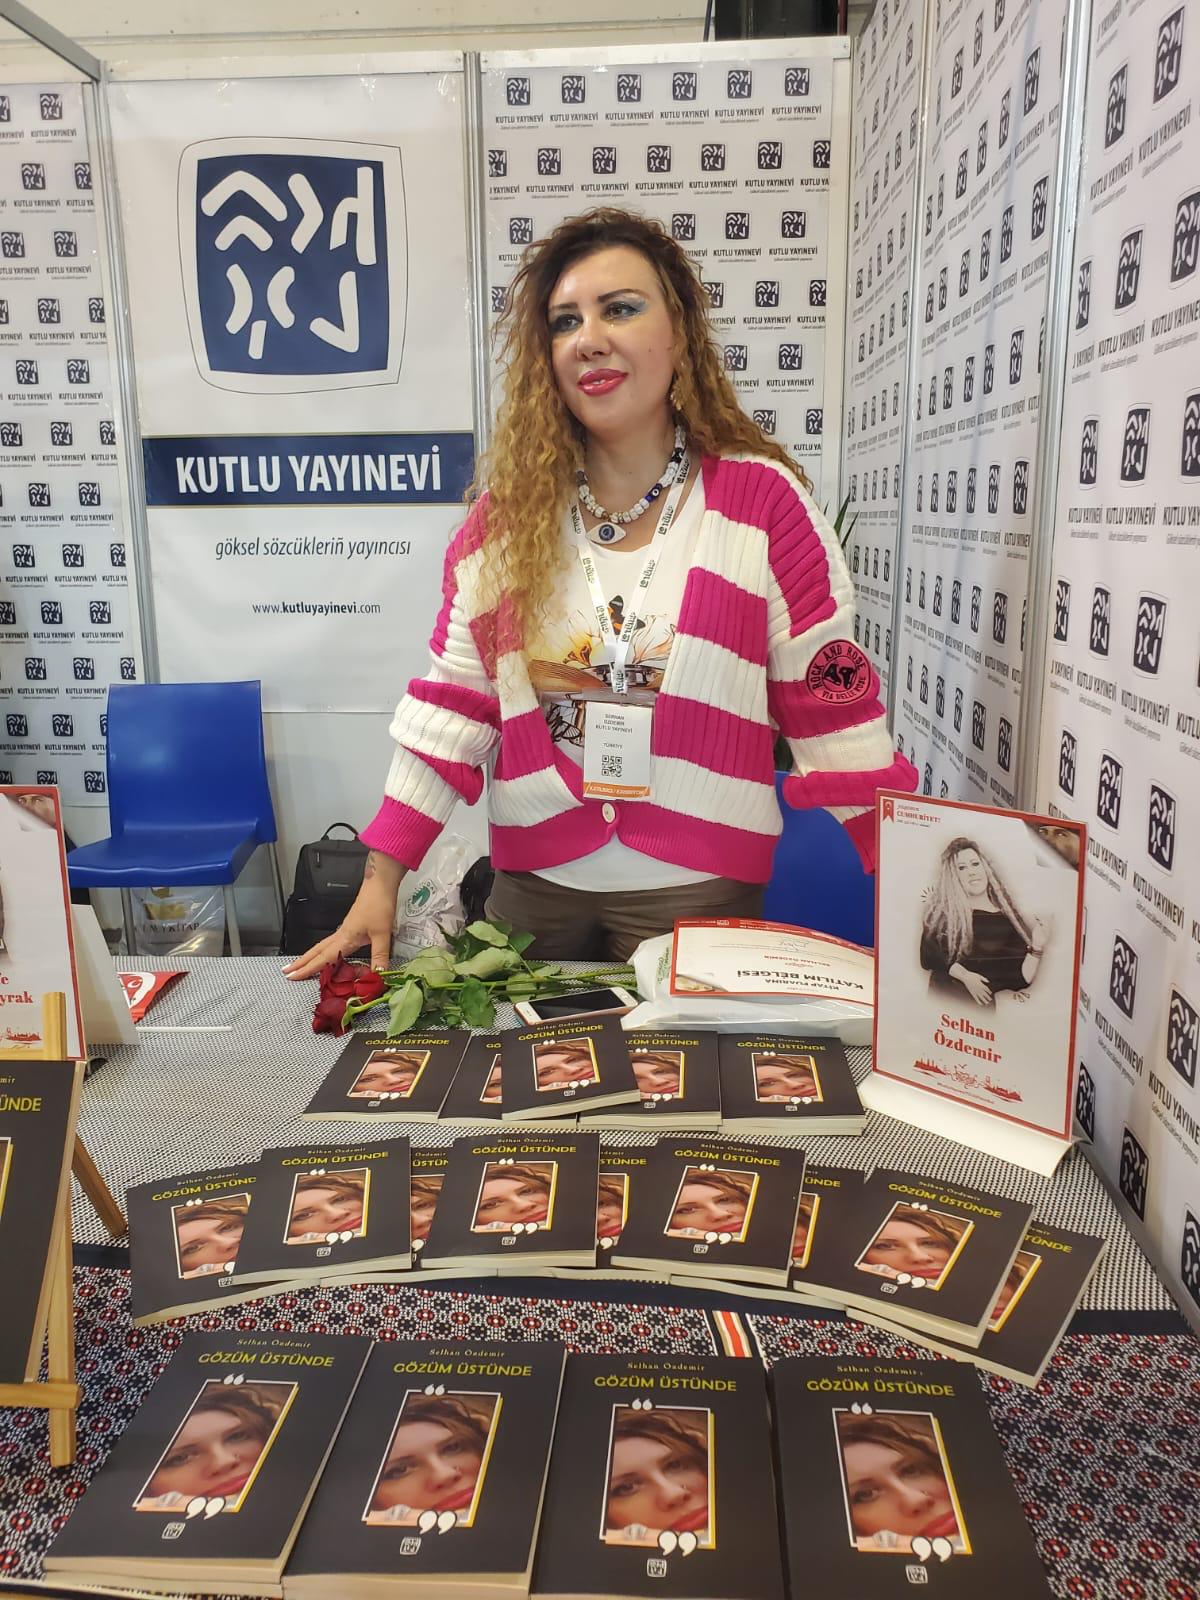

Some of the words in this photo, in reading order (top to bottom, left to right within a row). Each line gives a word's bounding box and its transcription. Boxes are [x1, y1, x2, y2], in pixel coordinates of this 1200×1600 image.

[550, 114, 569, 122] KUTLU
[571, 112, 599, 121] YAYINEVİ
[626, 110, 654, 120] YAYINEVİ
[682, 109, 710, 118] YAYINEVİ
[736, 108, 764, 116] YAYINEVİ
[793, 106, 822, 114] YAYINEVİ
[517, 114, 544, 123] YAYINEVİ
[1139, 135, 1158, 164] KUTLU
[1160, 99, 1191, 146] YAYINEVİ
[1090, 179, 1108, 201] KUTLU
[1108, 147, 1134, 188] YAYINEVİ
[547, 183, 574, 192] YAYINEVİ
[581, 184, 600, 192] KUTLU
[601, 182, 629, 191] YAYINEVİ
[655, 180, 684, 189] YAYINEVİ
[689, 181, 709, 189] KUTLU
[710, 179, 738, 187] YAYINEVİ
[765, 178, 794, 186] YAYINEVİ
[499, 254, 518, 262] KUTLU
[734, 248, 762, 256] YAYINEVİ
[769, 248, 789, 256] KUTLU
[790, 246, 818, 255] YAYINEVİ
[764, 315, 791, 324] YAYINEVİ
[1151, 312, 1173, 338] KUTLU
[1098, 335, 1118, 358] KUTLU
[1119, 320, 1146, 352] YAYINEVİ
[767, 379, 786, 387] KUTLU
[787, 378, 814, 386] YAYINEVİ
[176, 456, 281, 494] KUTLU
[288, 445, 441, 492] YAYINEVİ
[1106, 507, 1124, 525] KUTLU
[1125, 502, 1156, 525] YAYINEVİ
[1163, 507, 1187, 526] KUTLU
[215, 537, 260, 560] göksel
[264, 537, 344, 556] sözcükleriñ
[347, 540, 411, 560] yayıncısı
[252, 601, 381, 617] www.kutluyayinevi.com
[811, 664, 824, 690] ROCK
[823, 645, 842, 661] AND
[1077, 670, 1093, 691] KUTLU
[1094, 675, 1117, 702] YAYINEVİ
[1122, 689, 1138, 712] KUTLU
[1139, 697, 1170, 727] YAYINEVİ
[1176, 712, 1200, 740] KUTLU
[1101, 846, 1128, 880] YAYINEVİ
[1133, 871, 1153, 902] KUTLU
[1154, 888, 1185, 930] YAYINEVİ
[737, 969, 799, 979] BELGESİ
[803, 973, 864, 990] KATILIM
[518, 1032, 555, 1041] GÖZÜM
[557, 1024, 604, 1038] ÜSTÜNDE
[941, 1014, 995, 1042] Selhan
[934, 1029, 1002, 1064] Özdemir
[1096, 1009, 1114, 1042] KUTLU
[1114, 1030, 1144, 1076] YAYINEVİ
[1149, 1070, 1172, 1111] KUTLU
[1173, 1098, 1200, 1145] YAYINE
[472, 1146, 517, 1154] GÖZÜM
[282, 1156, 328, 1166] GÖZÜM
[332, 1152, 389, 1163] ÜSTÜNDE
[674, 1150, 719, 1160] GÖZÜM
[722, 1154, 781, 1167] ÜSTÜNDE
[152, 1187, 201, 1201] GÖZÜM
[888, 1183, 936, 1201] GÖZÜM
[939, 1195, 1002, 1218] ÜSTÜNDE
[198, 1352, 257, 1364] GÖZÜM
[260, 1352, 335, 1367] ÜSTÜNDE
[429, 1348, 460, 1356] Selhan
[394, 1361, 453, 1373] GÖZÜM
[457, 1362, 532, 1376] ÜSTÜNDE
[627, 1362, 659, 1370] Selhan
[837, 1365, 870, 1373] Selhan
[594, 1374, 654, 1388] GÖZÜM
[660, 1376, 737, 1392] ÜSTÜNDE
[807, 1379, 869, 1392] GÖZÜM
[874, 1379, 955, 1397] ÜSTÜNDE
